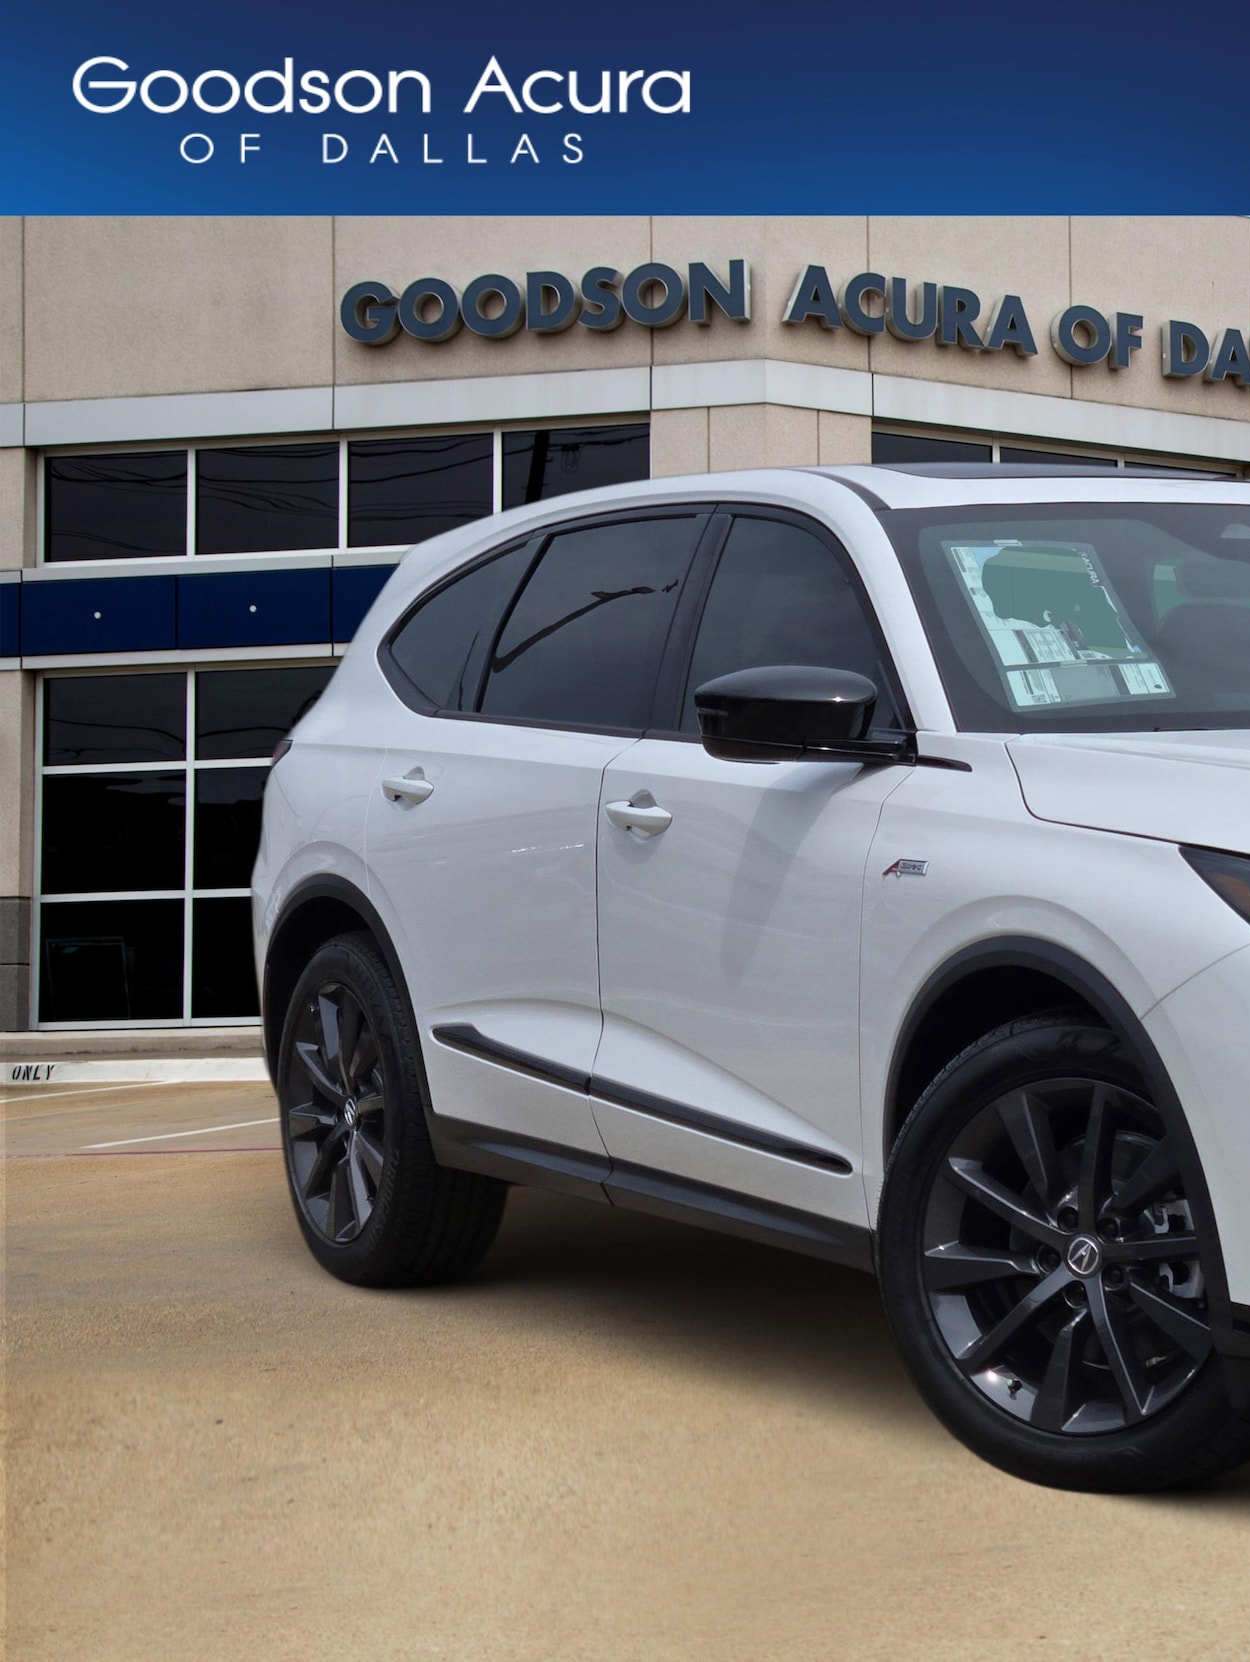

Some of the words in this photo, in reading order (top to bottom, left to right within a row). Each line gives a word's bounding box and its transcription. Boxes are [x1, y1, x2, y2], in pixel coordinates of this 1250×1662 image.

[339, 258, 751, 346] GOODSON
[782, 264, 1038, 358] ACURA
[1051, 304, 1143, 369] OF
[12, 1064, 55, 1081] ONLY
